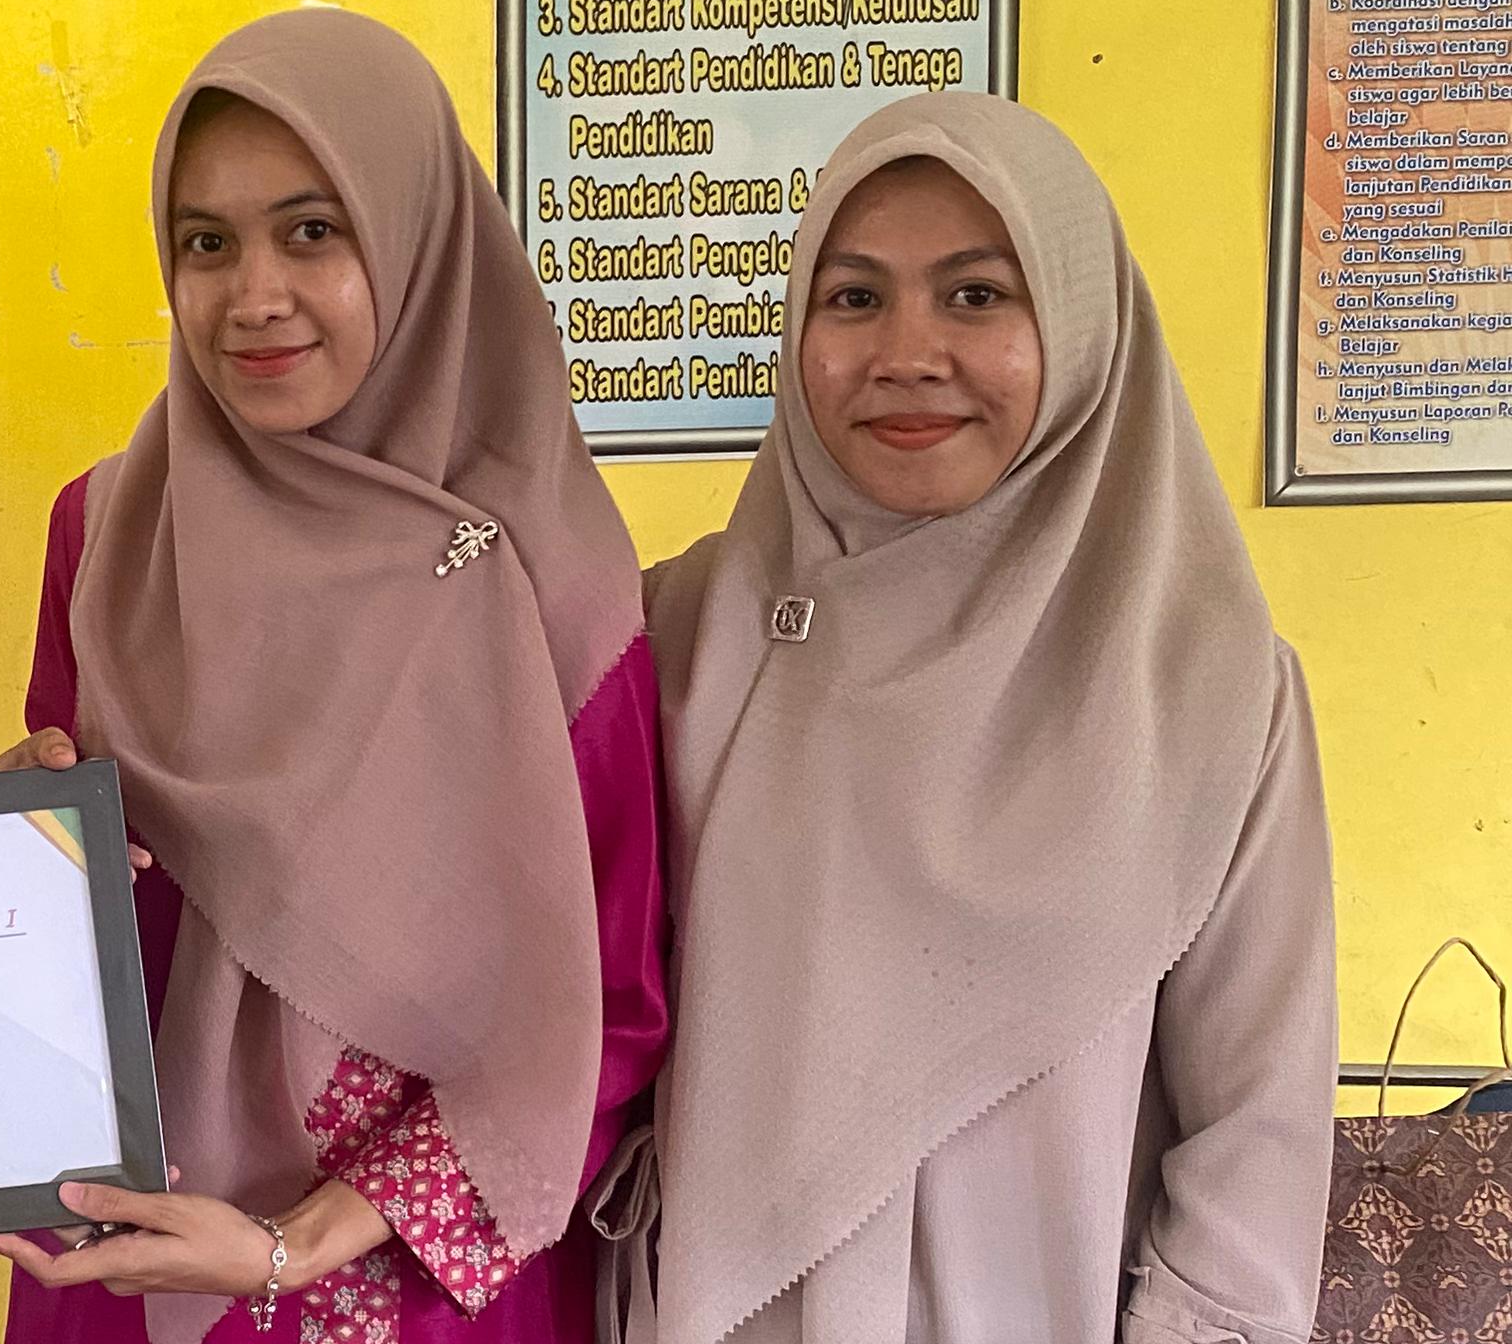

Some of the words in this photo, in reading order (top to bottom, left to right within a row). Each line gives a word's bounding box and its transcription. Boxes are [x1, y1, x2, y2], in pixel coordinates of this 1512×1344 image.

[538, 53, 563, 96] 4.
[569, 49, 684, 96] Standart
[691, 43, 834, 92] Pendidikan
[840, 42, 861, 86] &
[868, 41, 962, 92] Tenaga
[1348, 110, 1407, 128] belajar
[570, 108, 713, 158] Pendidikan
[1343, 248, 1373, 263] dan
[1381, 245, 1462, 265] Konseling
[6, 908, 17, 928] I
